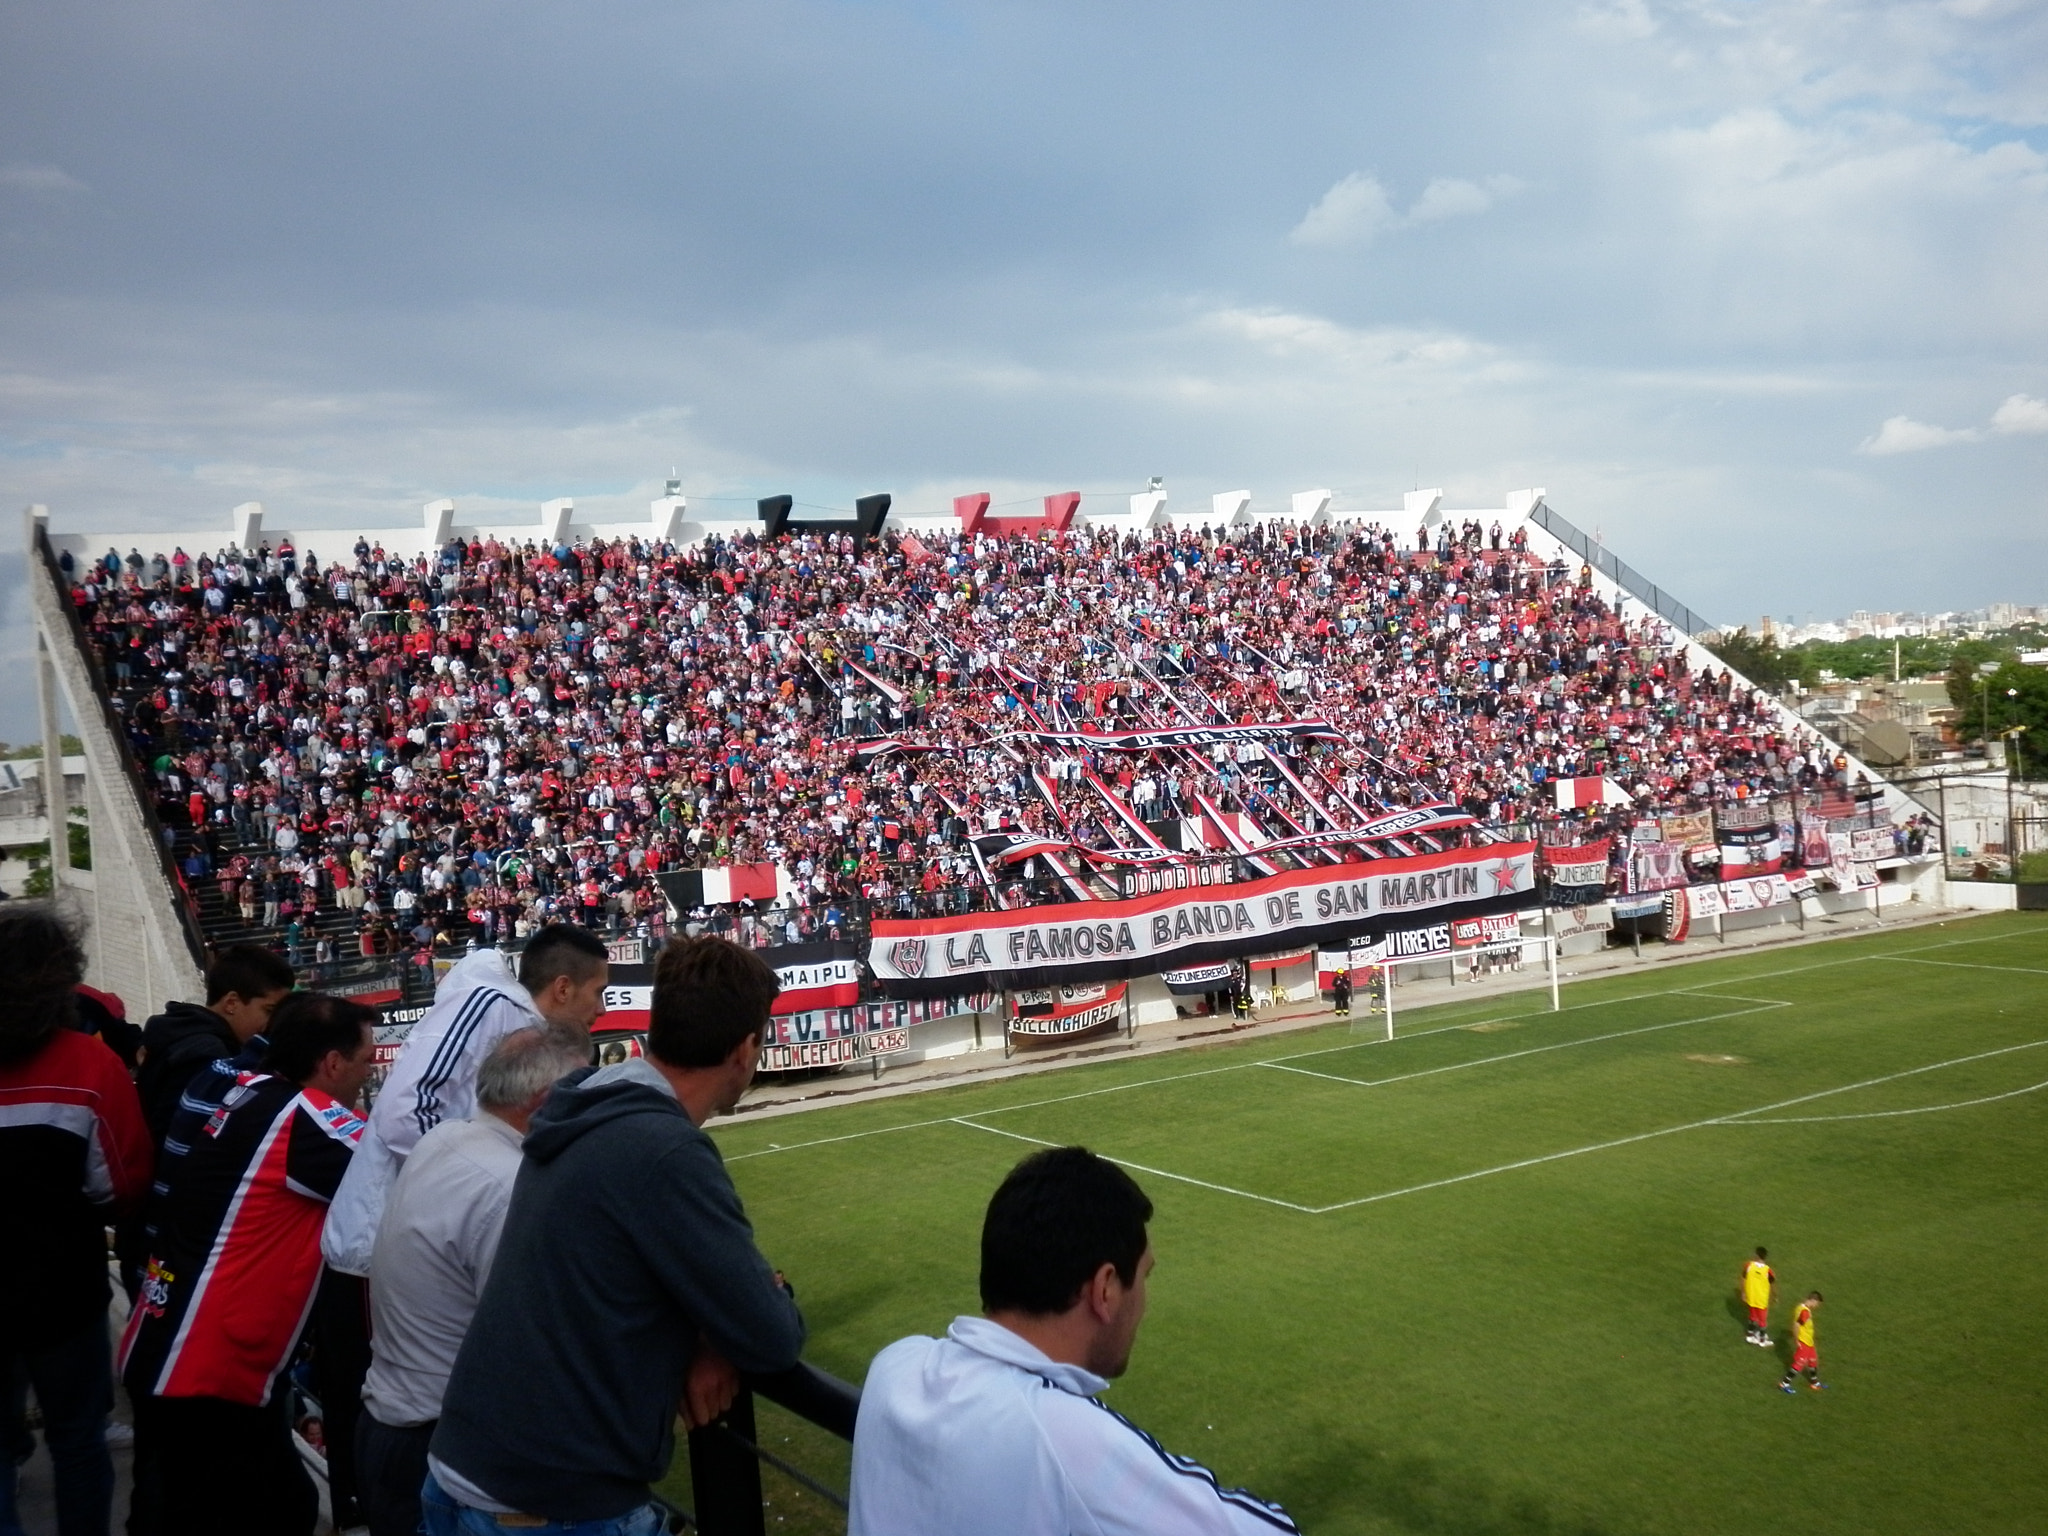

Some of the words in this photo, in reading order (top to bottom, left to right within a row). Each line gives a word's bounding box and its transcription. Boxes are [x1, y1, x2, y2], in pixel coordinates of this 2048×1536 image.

[1135, 734, 1163, 746] DE
[1174, 731, 1214, 746] SAN
[946, 933, 992, 968] LA
[1009, 922, 1136, 963] FAMOSA
[1152, 902, 1255, 949] BANDA
[1267, 891, 1303, 927] DE
[1317, 883, 1369, 918] SAN
[1382, 867, 1478, 909] MARTIN
[1482, 915, 1518, 931] BATALLA
[604, 942, 640, 961] STER
[1385, 925, 1450, 956] VIRREYES
[783, 965, 846, 986] MAIPU
[824, 993, 959, 1039] CONCEPCION
[1013, 1003, 1117, 1034] BILLINGHURST
[772, 1037, 861, 1069] CONCEPCION
